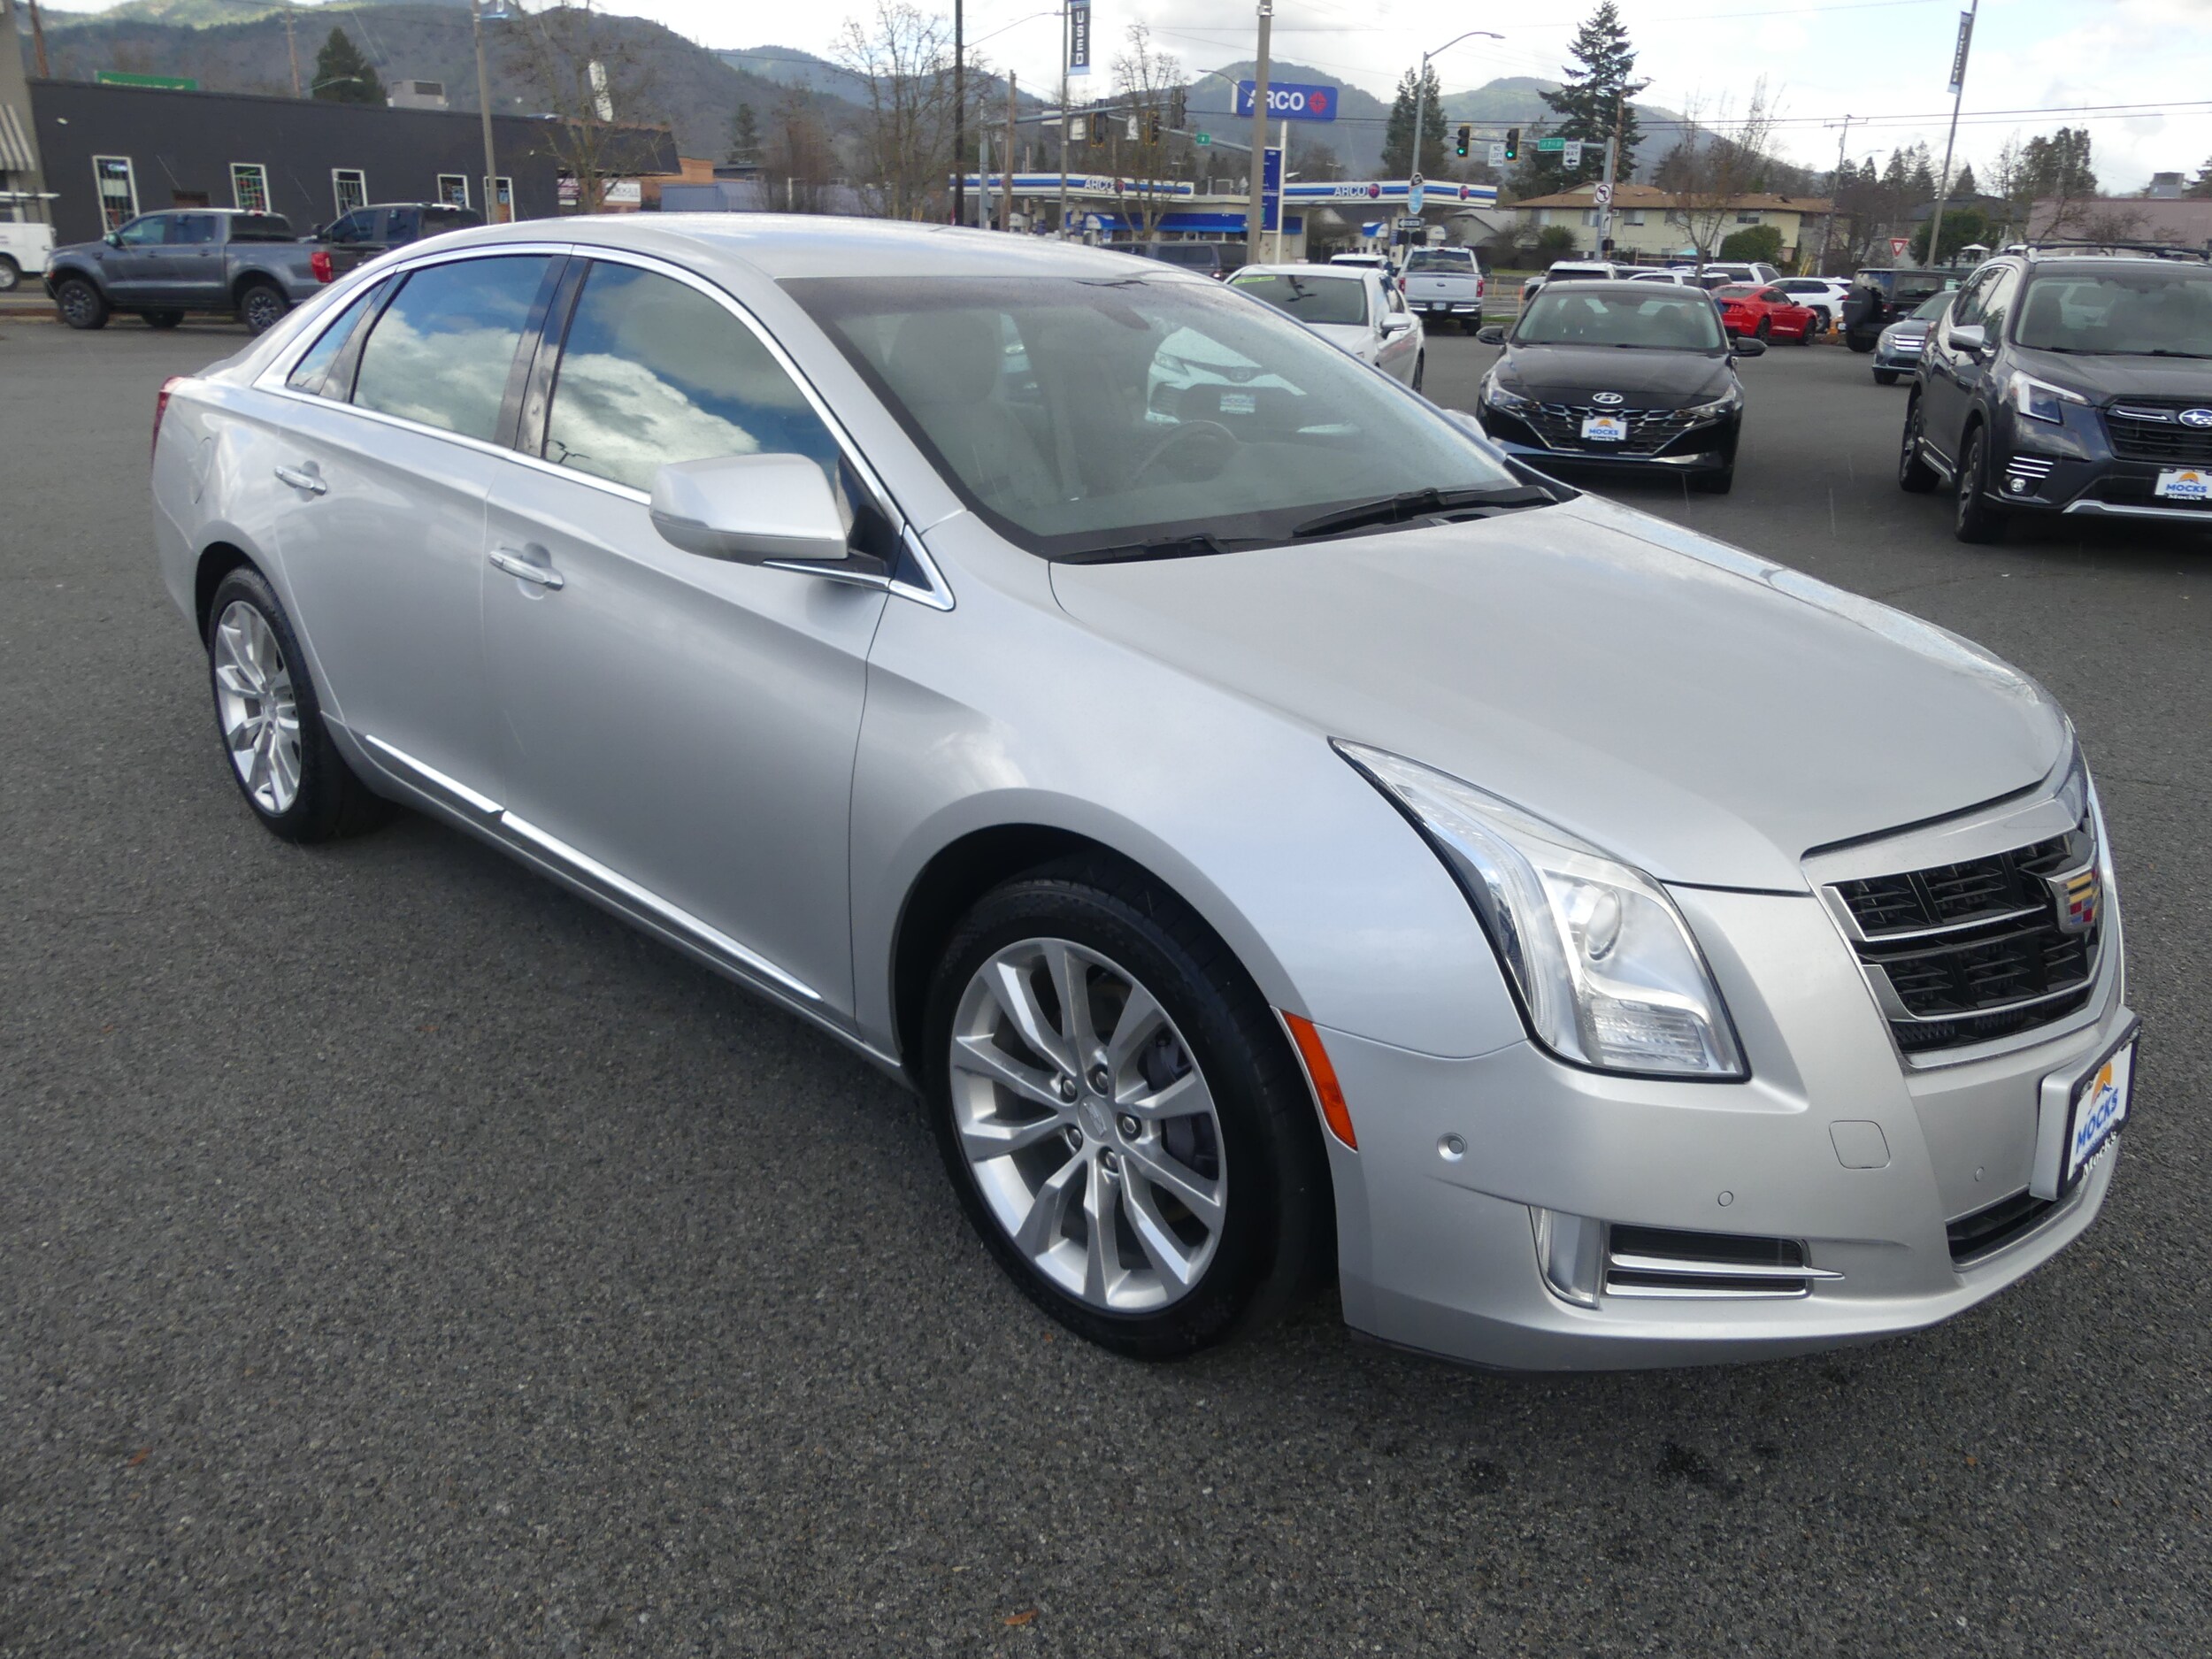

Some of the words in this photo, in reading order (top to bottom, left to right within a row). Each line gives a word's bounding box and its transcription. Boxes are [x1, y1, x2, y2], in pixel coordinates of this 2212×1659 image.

[1076, 11, 1085, 65] USED
[1084, 179, 1115, 191] ARCO
[1333, 184, 1366, 196] ARCO
[2165, 483, 2208, 493] MOCKS
[2076, 1088, 2119, 1154] MOCKS
